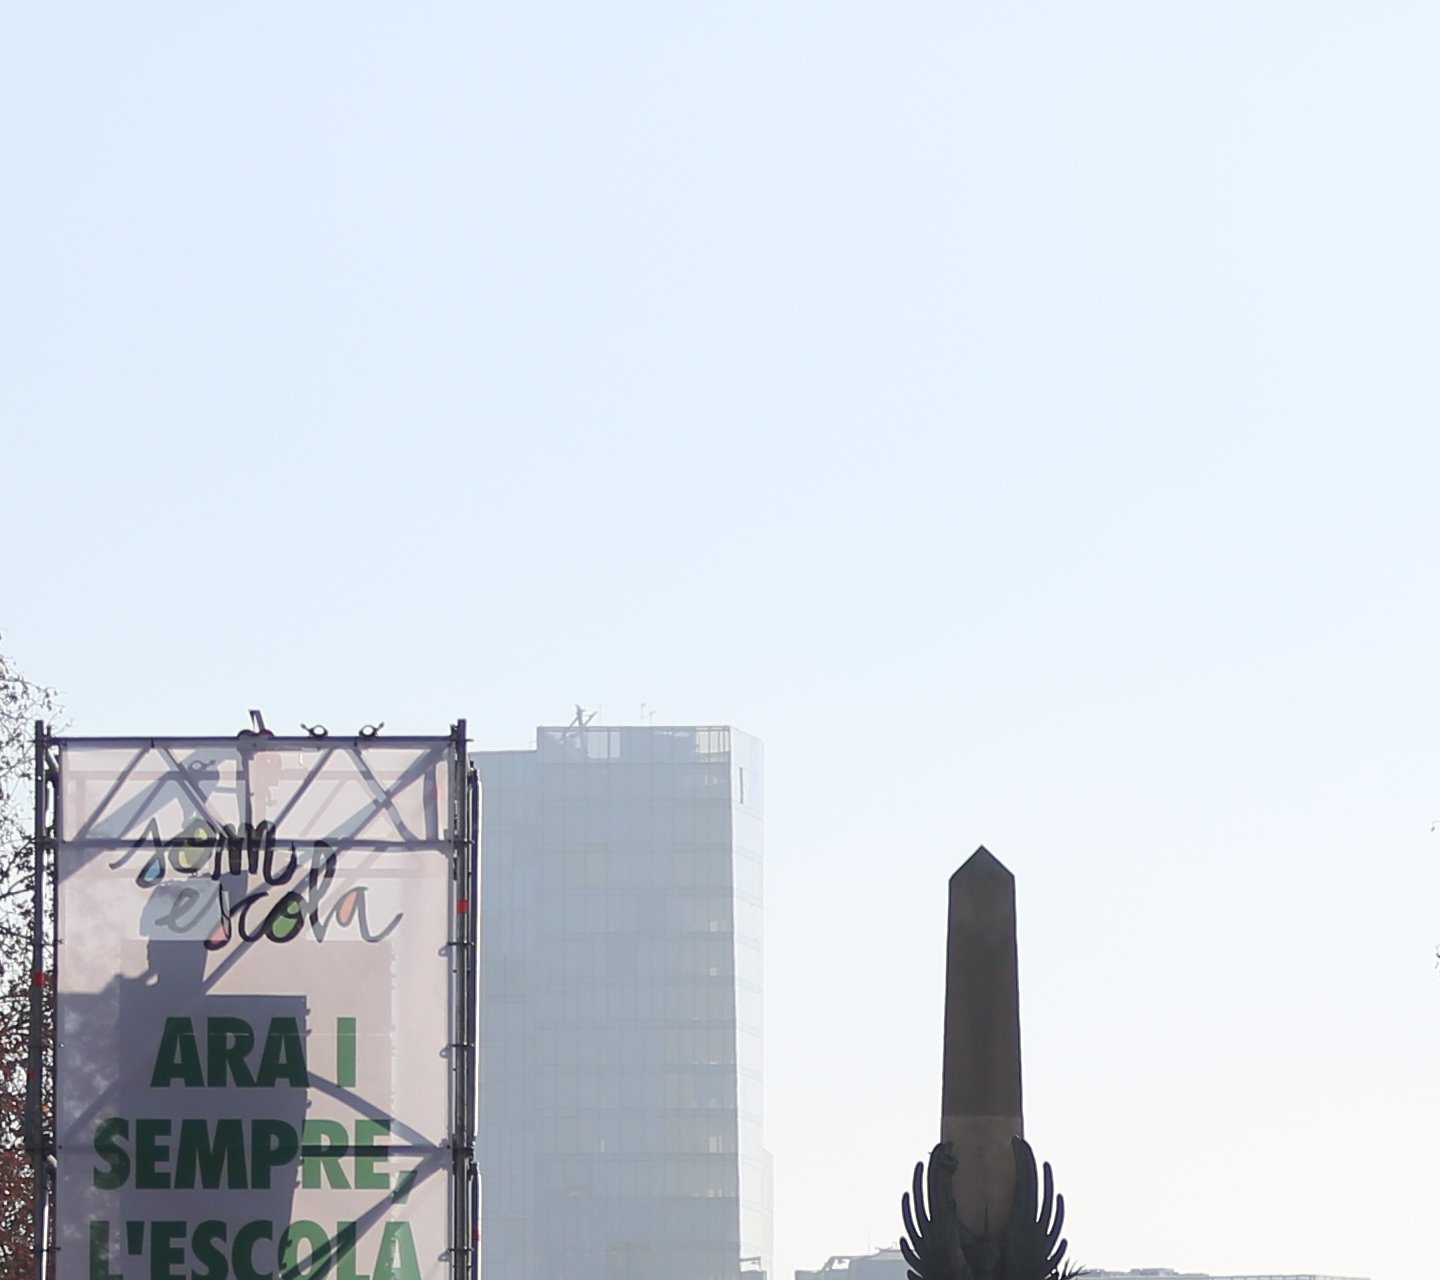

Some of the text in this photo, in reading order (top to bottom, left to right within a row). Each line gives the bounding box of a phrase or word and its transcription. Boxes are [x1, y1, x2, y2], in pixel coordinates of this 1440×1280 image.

[149, 1016, 358, 1089] ARA I
[92, 1117, 416, 1204] SEMPRE,
